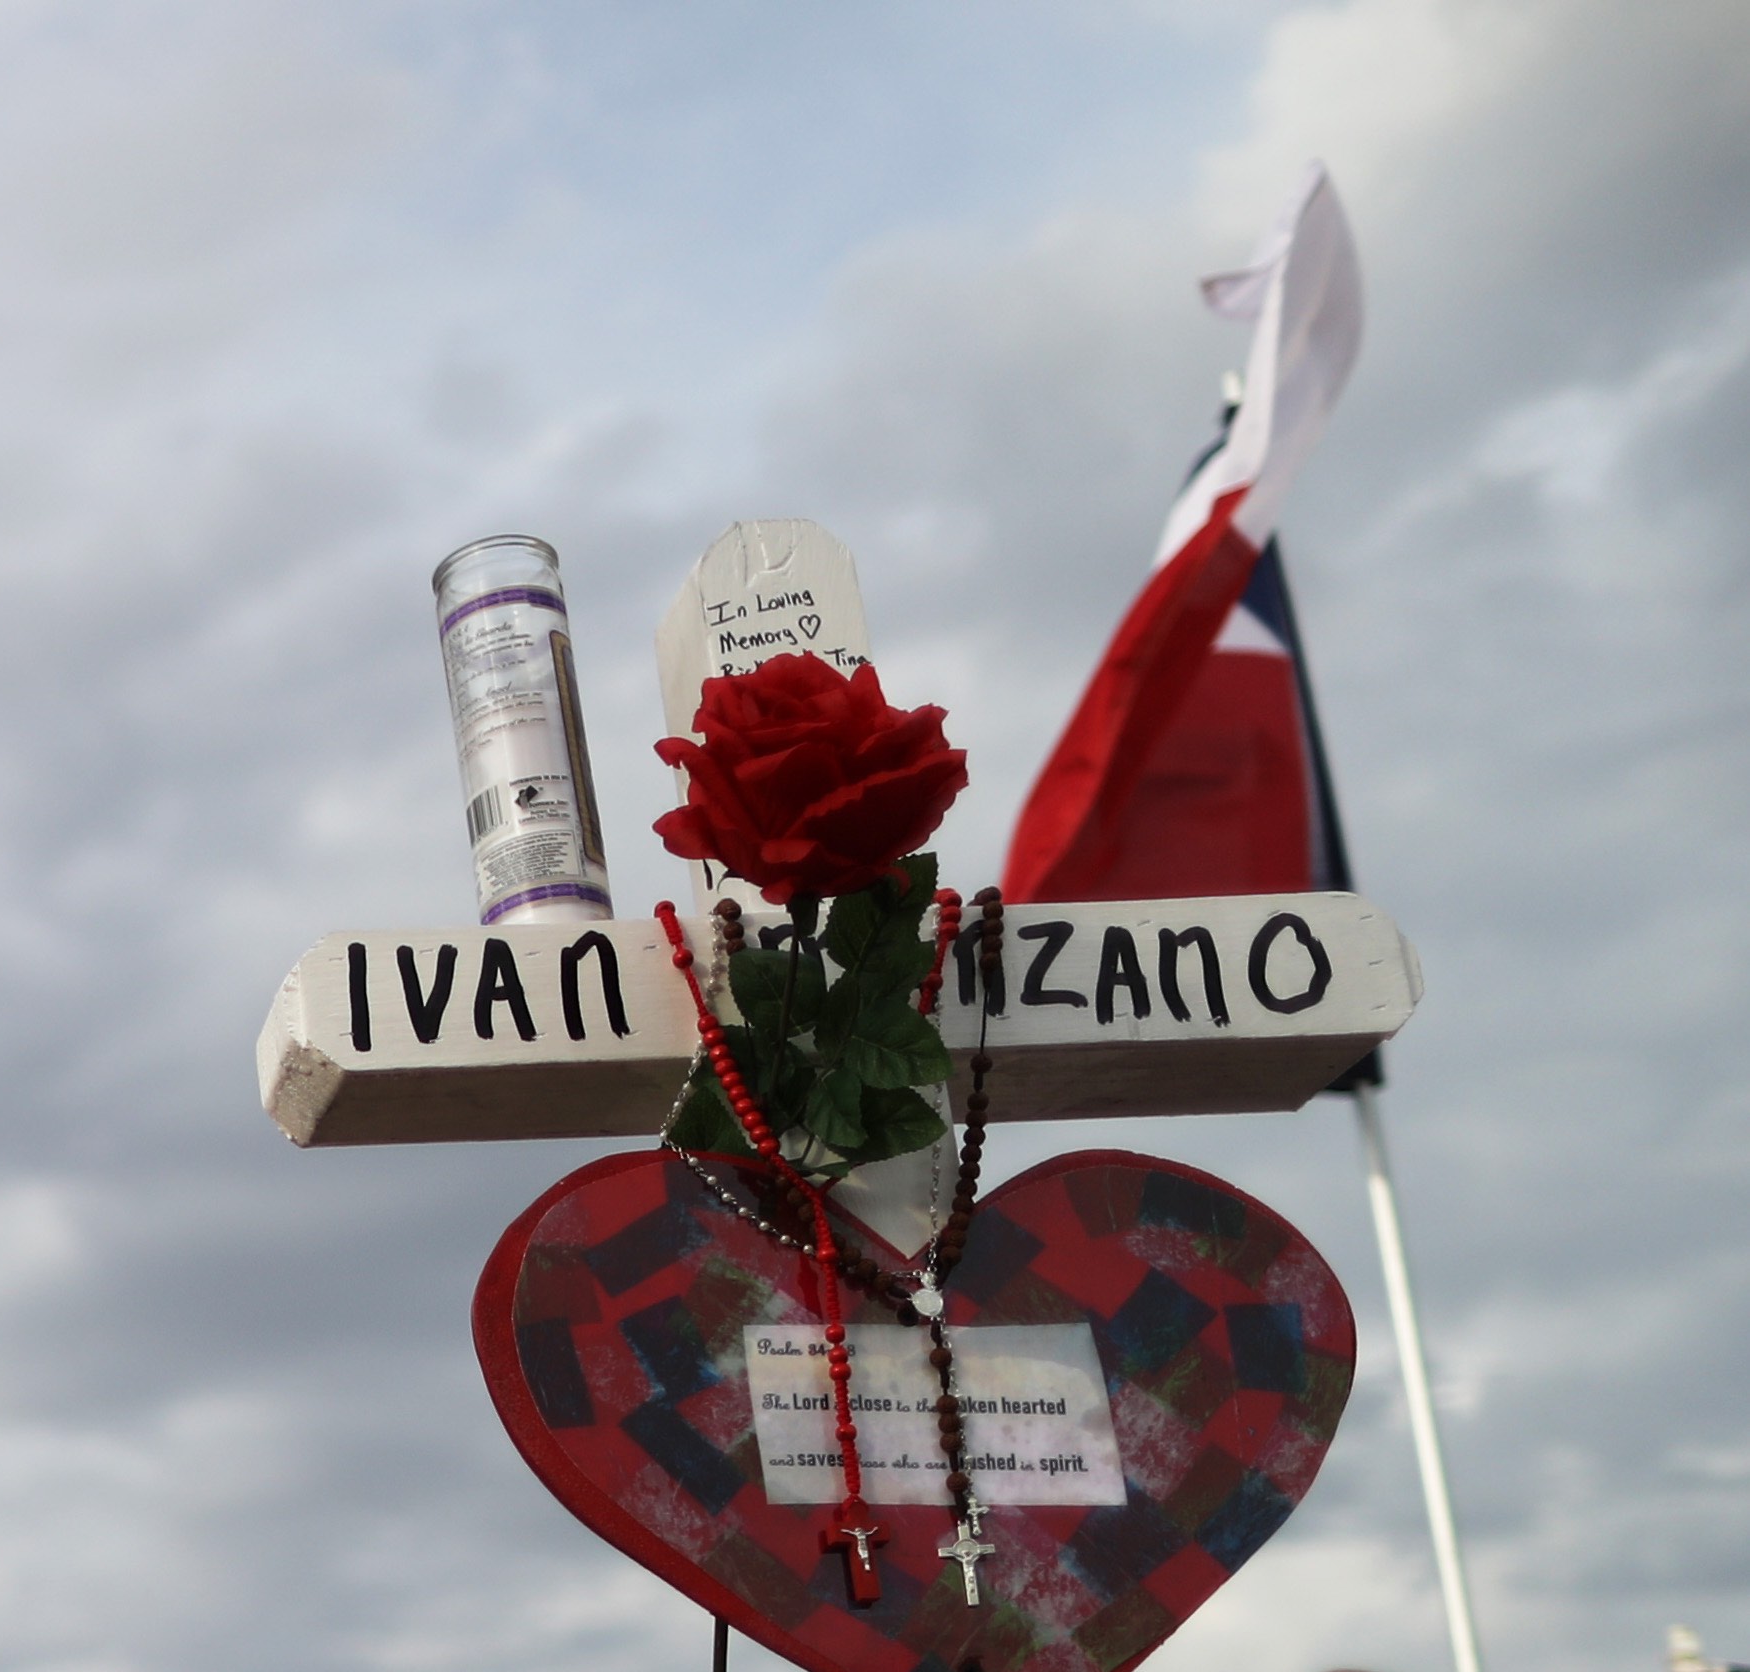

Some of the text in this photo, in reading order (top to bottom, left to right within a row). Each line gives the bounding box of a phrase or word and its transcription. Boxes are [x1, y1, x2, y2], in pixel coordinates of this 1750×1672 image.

[707, 589, 814, 626] In Loving
[720, 628, 798, 654] Memory
[824, 648, 872, 667] Tina
[758, 912, 1333, 1028] NZANO
[757, 1338, 802, 1357] Psalm
[762, 1394, 791, 1412] The
[793, 1393, 829, 1411] Lord
[850, 1395, 892, 1412] close
[958, 1396, 998, 1414] oken
[1002, 1396, 1066, 1415] hearted
[769, 1455, 795, 1467] and
[797, 1453, 844, 1468] saves
[857, 1456, 888, 1470] hose
[892, 1456, 920, 1470] who
[924, 1459, 949, 1471] are
[1020, 1459, 1035, 1472] in
[1040, 1454, 1089, 1475] spirit.
